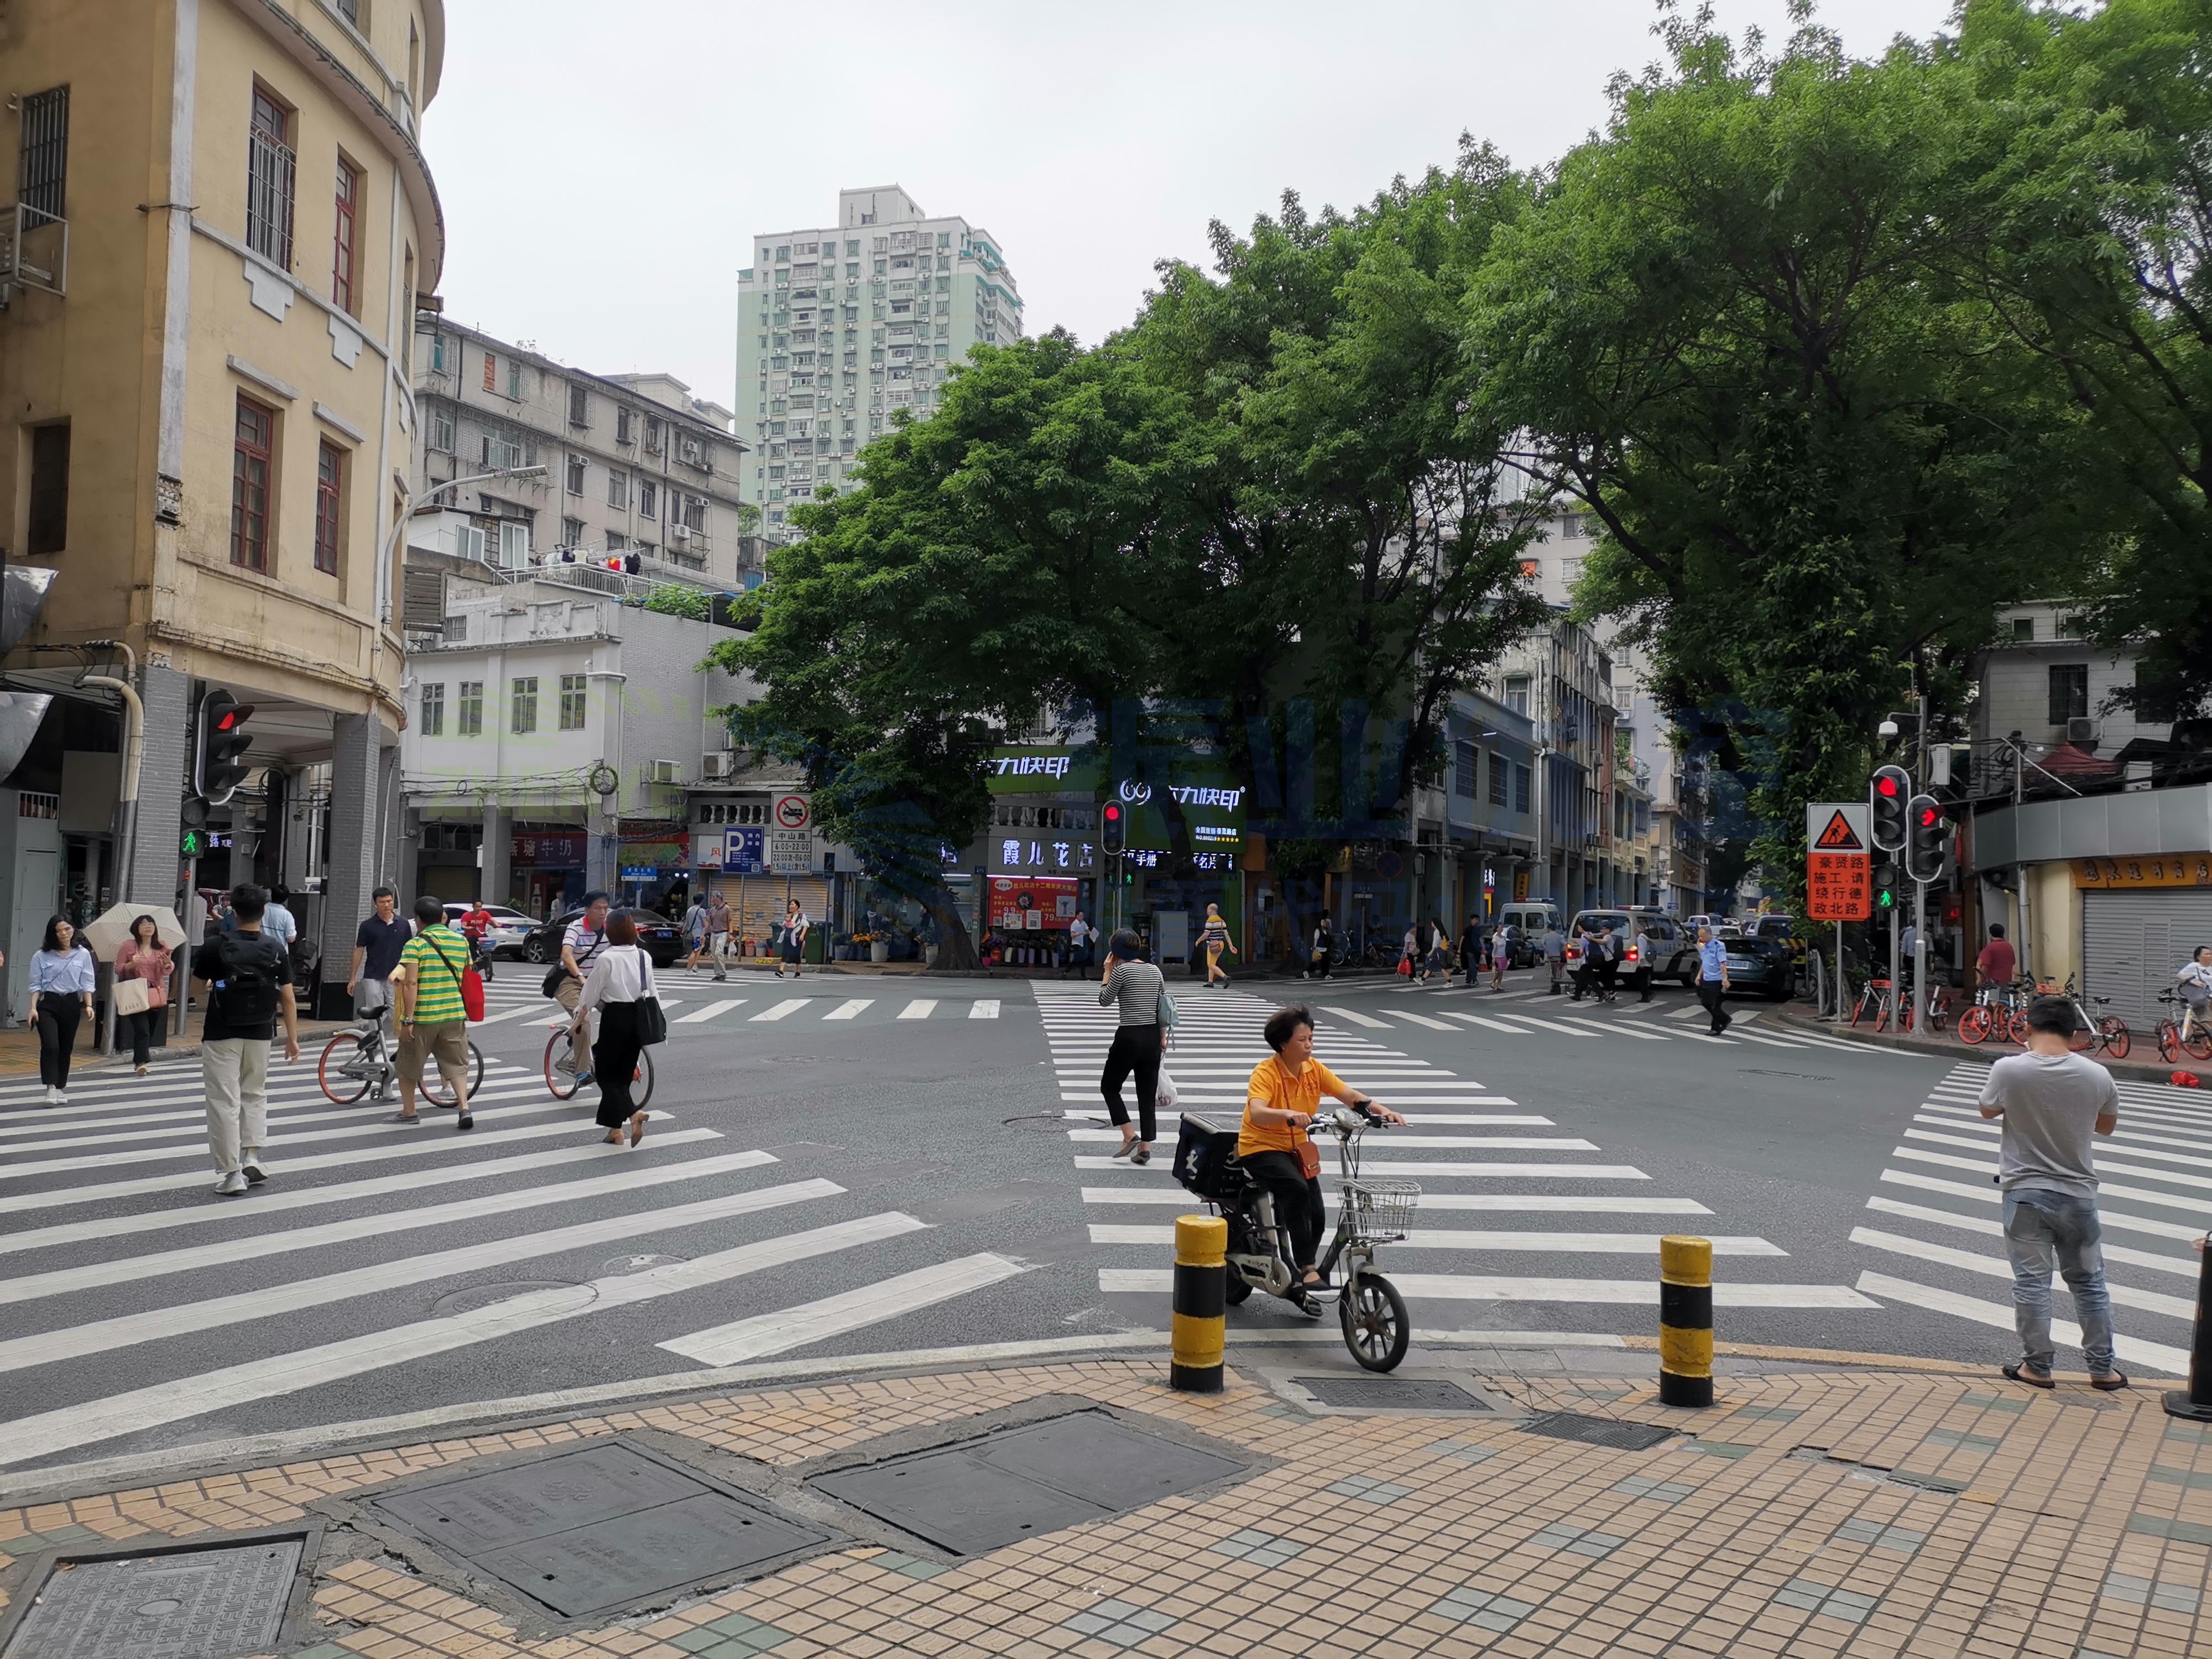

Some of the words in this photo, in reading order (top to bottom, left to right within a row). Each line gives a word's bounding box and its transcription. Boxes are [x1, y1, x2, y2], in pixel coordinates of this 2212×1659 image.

[725, 831, 744, 863] P
[1002, 839, 1093, 867] 霞儿花店
[1819, 857, 1864, 869] 豪贤路
[1815, 886, 1863, 899] 绕行德
